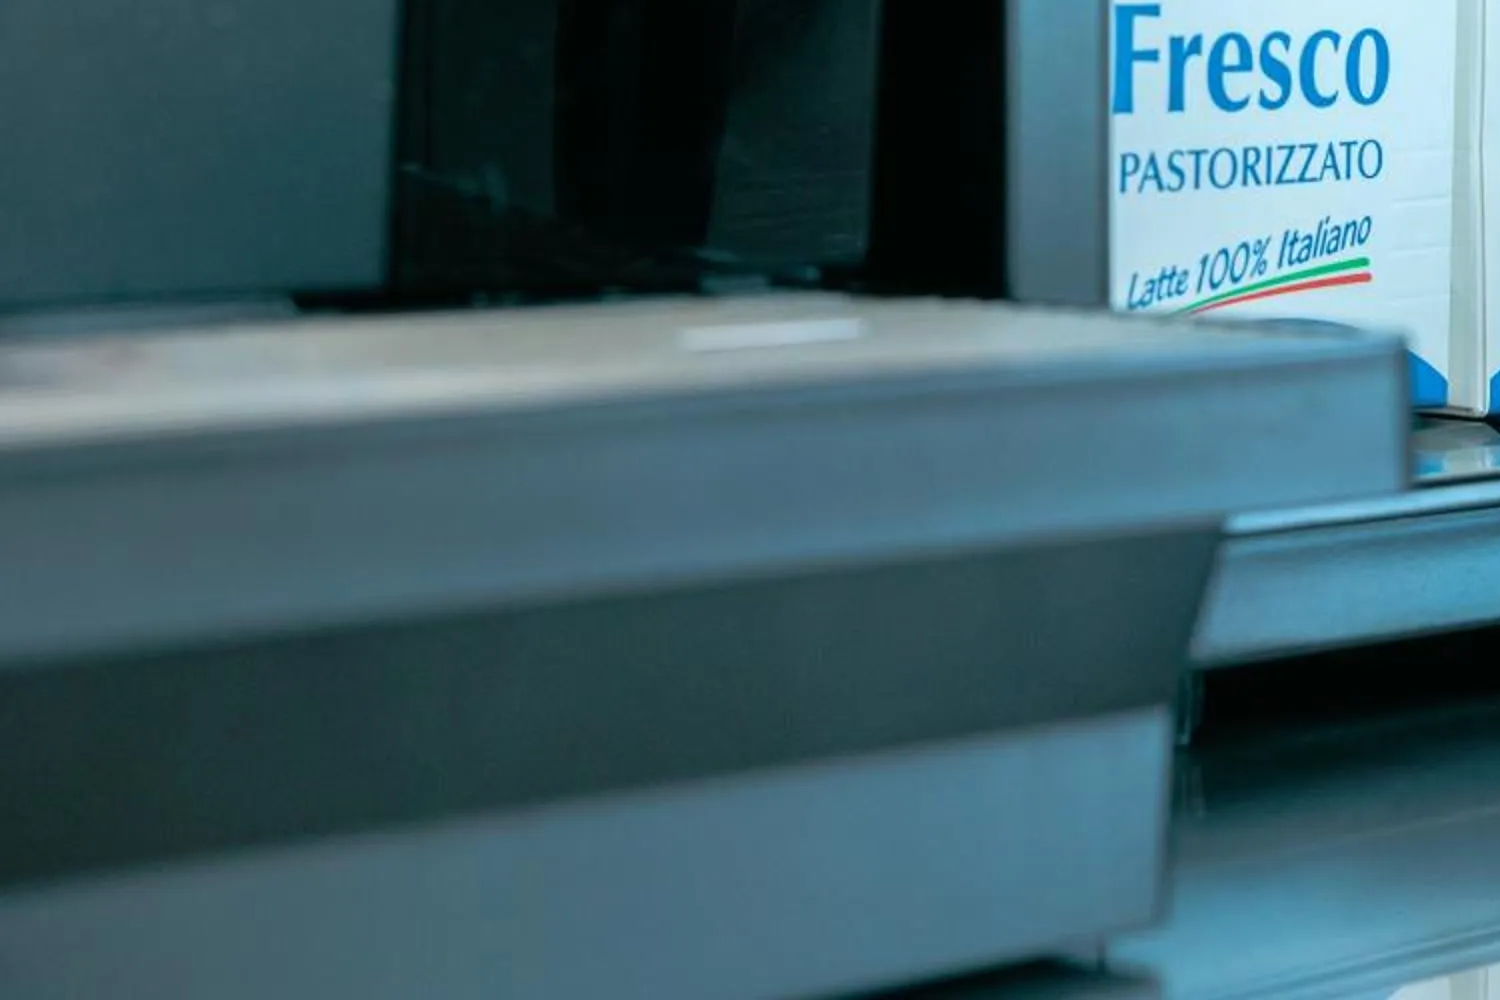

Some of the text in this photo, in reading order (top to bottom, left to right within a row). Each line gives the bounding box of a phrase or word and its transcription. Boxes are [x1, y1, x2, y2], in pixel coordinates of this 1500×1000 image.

[1111, 3, 1390, 114] Fresco
[1118, 138, 1383, 194] PASTORIZZATO
[1126, 215, 1372, 311] Latte 100% Italiano
